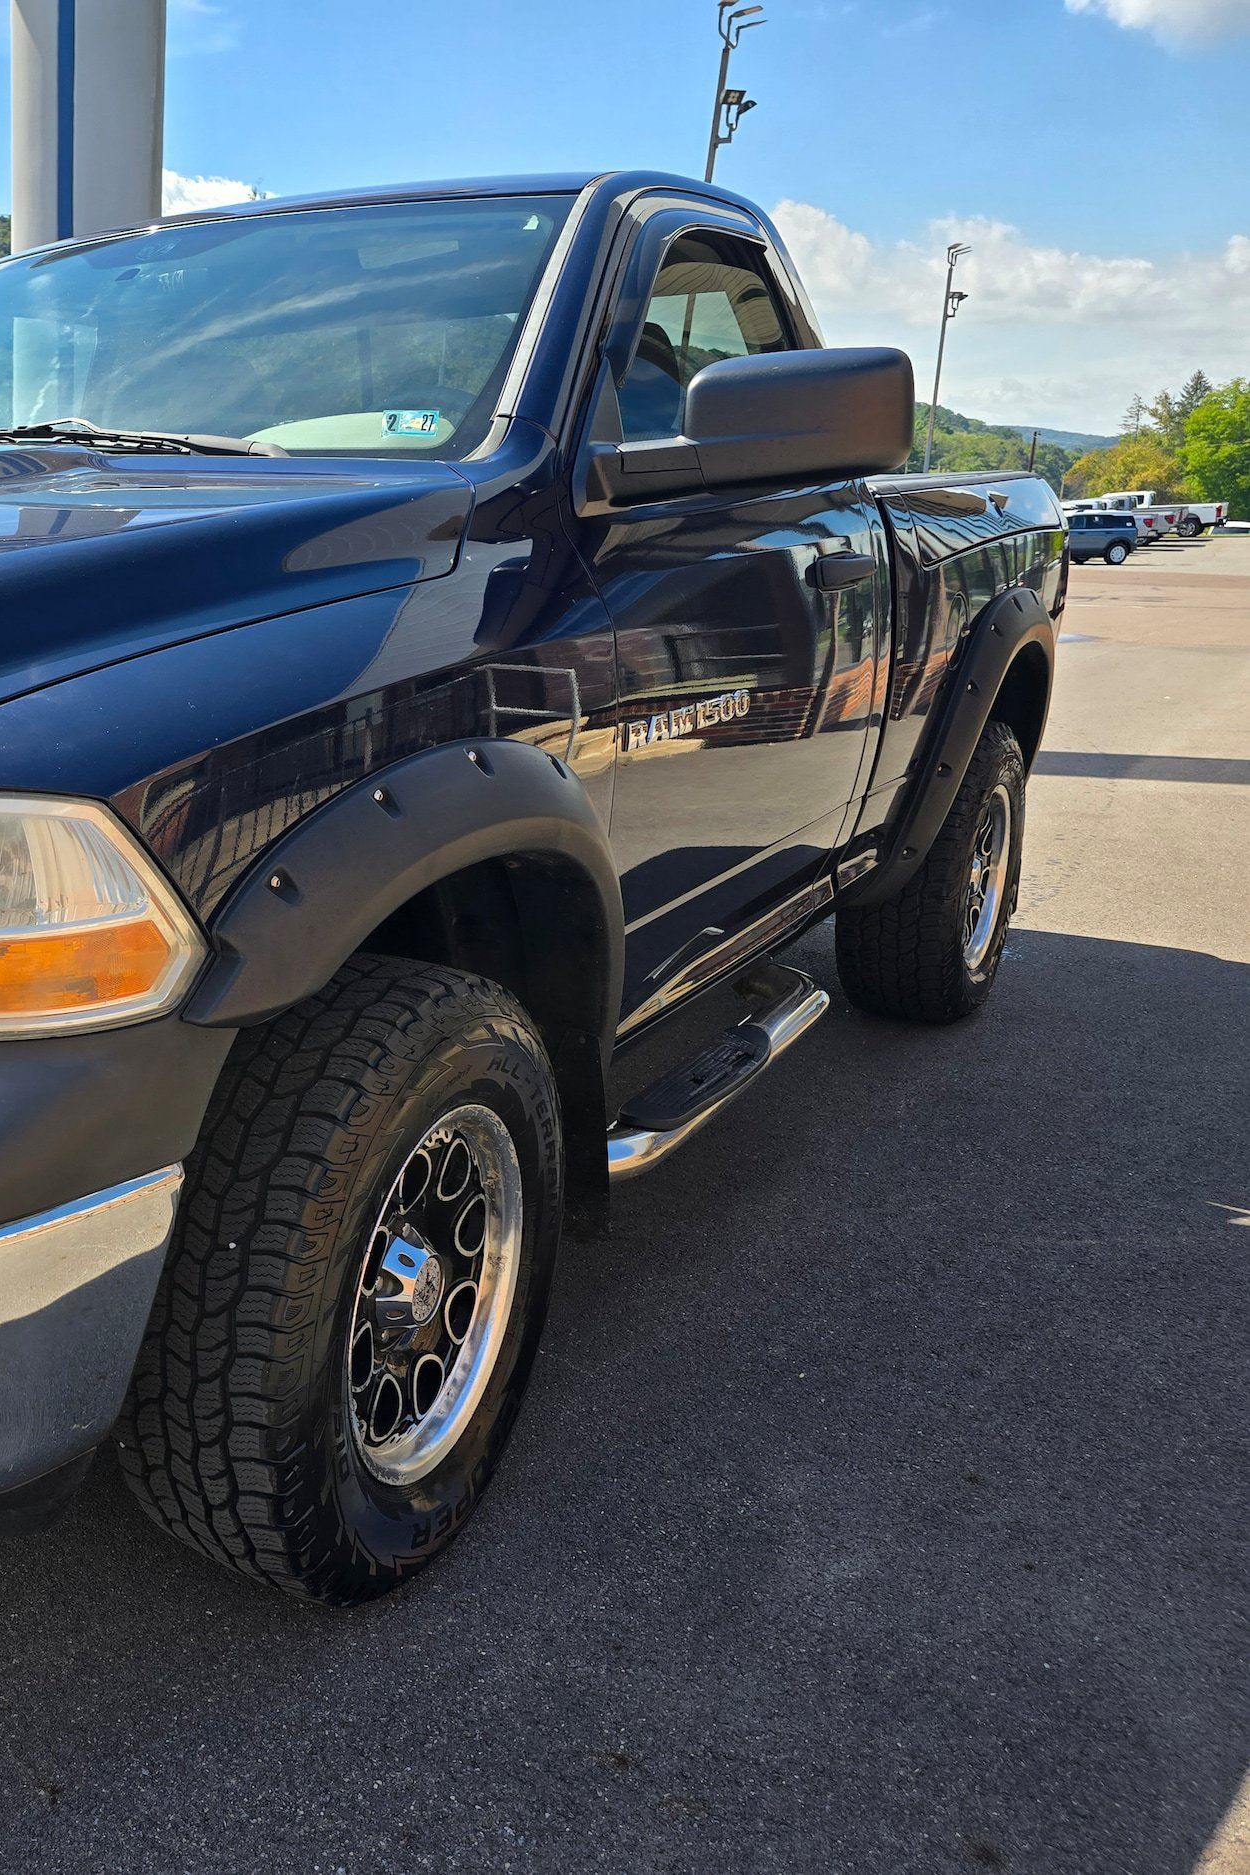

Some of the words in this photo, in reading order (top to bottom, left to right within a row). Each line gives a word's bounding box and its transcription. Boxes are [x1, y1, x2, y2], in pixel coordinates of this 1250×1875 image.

[387, 413, 398, 431] 2
[421, 414, 435, 432] 27
[624, 703, 696, 751] RAM
[696, 688, 751, 730] 1500
